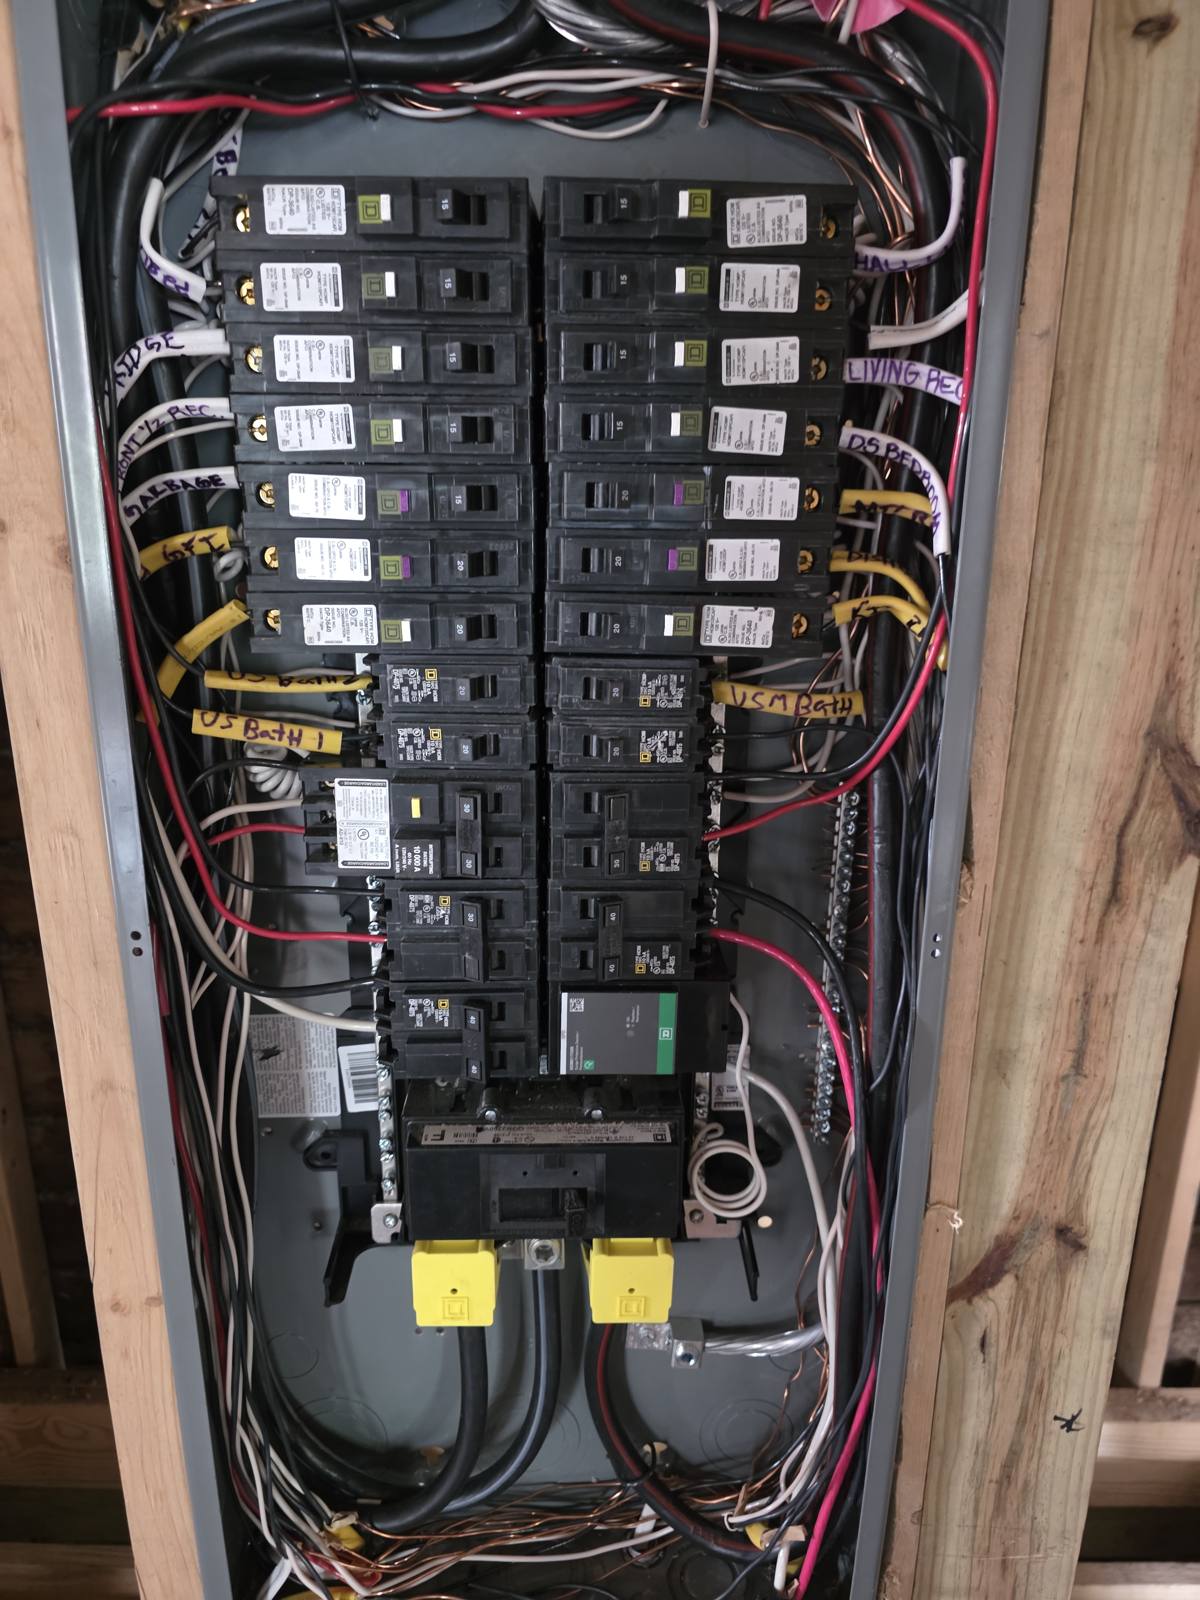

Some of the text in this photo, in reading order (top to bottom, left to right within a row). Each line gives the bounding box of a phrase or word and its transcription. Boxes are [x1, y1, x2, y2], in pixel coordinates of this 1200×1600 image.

[848, 358, 920, 386] LIVING
[847, 433, 880, 455] DS
[200, 711, 238, 730] US
